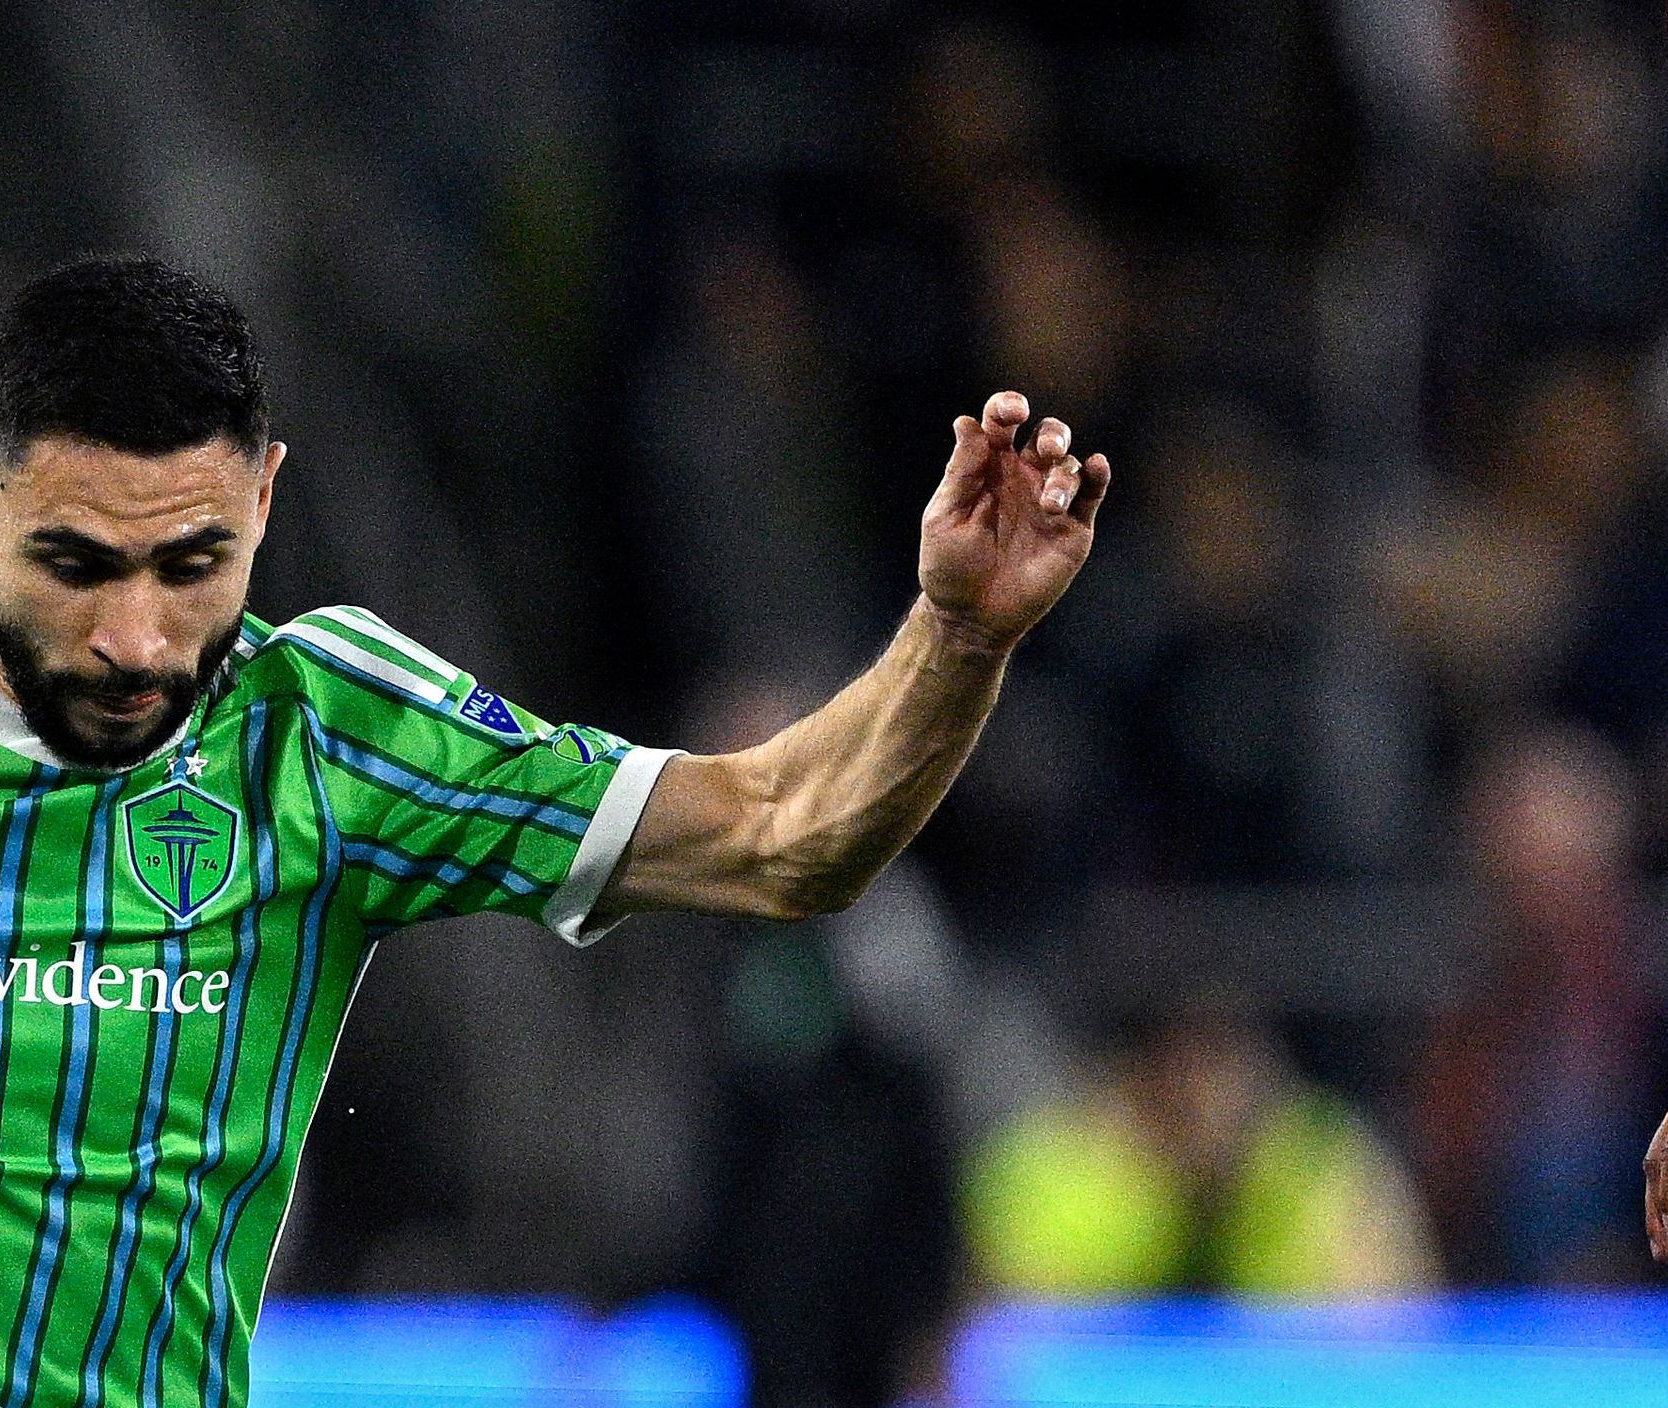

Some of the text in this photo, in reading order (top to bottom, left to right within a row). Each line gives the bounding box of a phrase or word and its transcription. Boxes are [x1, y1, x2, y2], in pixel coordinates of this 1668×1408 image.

[464, 688, 495, 720] MLS
[144, 855, 218, 871] 19 74
